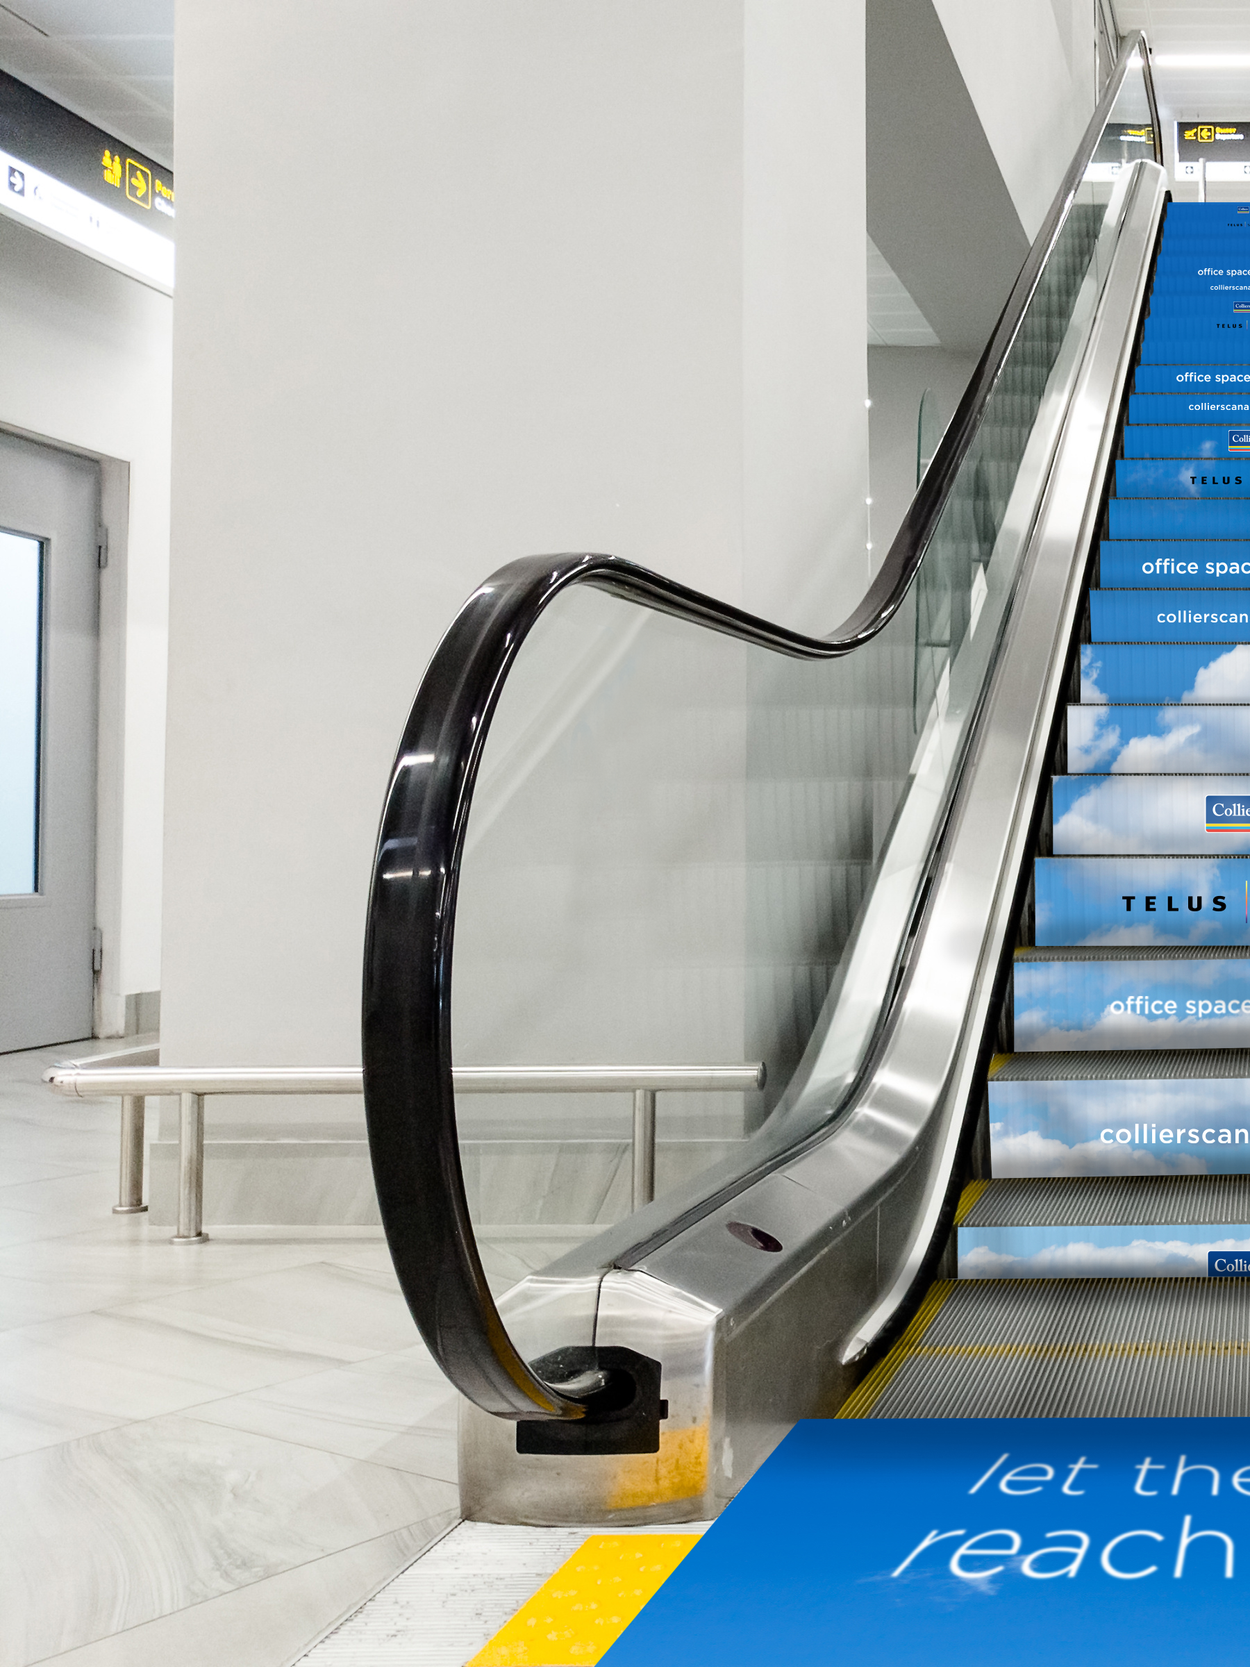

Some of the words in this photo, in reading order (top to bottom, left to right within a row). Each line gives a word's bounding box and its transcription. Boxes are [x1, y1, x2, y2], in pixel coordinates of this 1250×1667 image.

[1197, 268, 1223, 276] office
[1176, 372, 1211, 383] office
[1216, 374, 1250, 385] space
[1190, 475, 1243, 485] TELUS
[1142, 558, 1198, 575] office
[1122, 896, 1226, 912] TELUS
[1109, 995, 1178, 1016] office
[969, 1453, 1099, 1496] let
[891, 1514, 1236, 1580] reach
